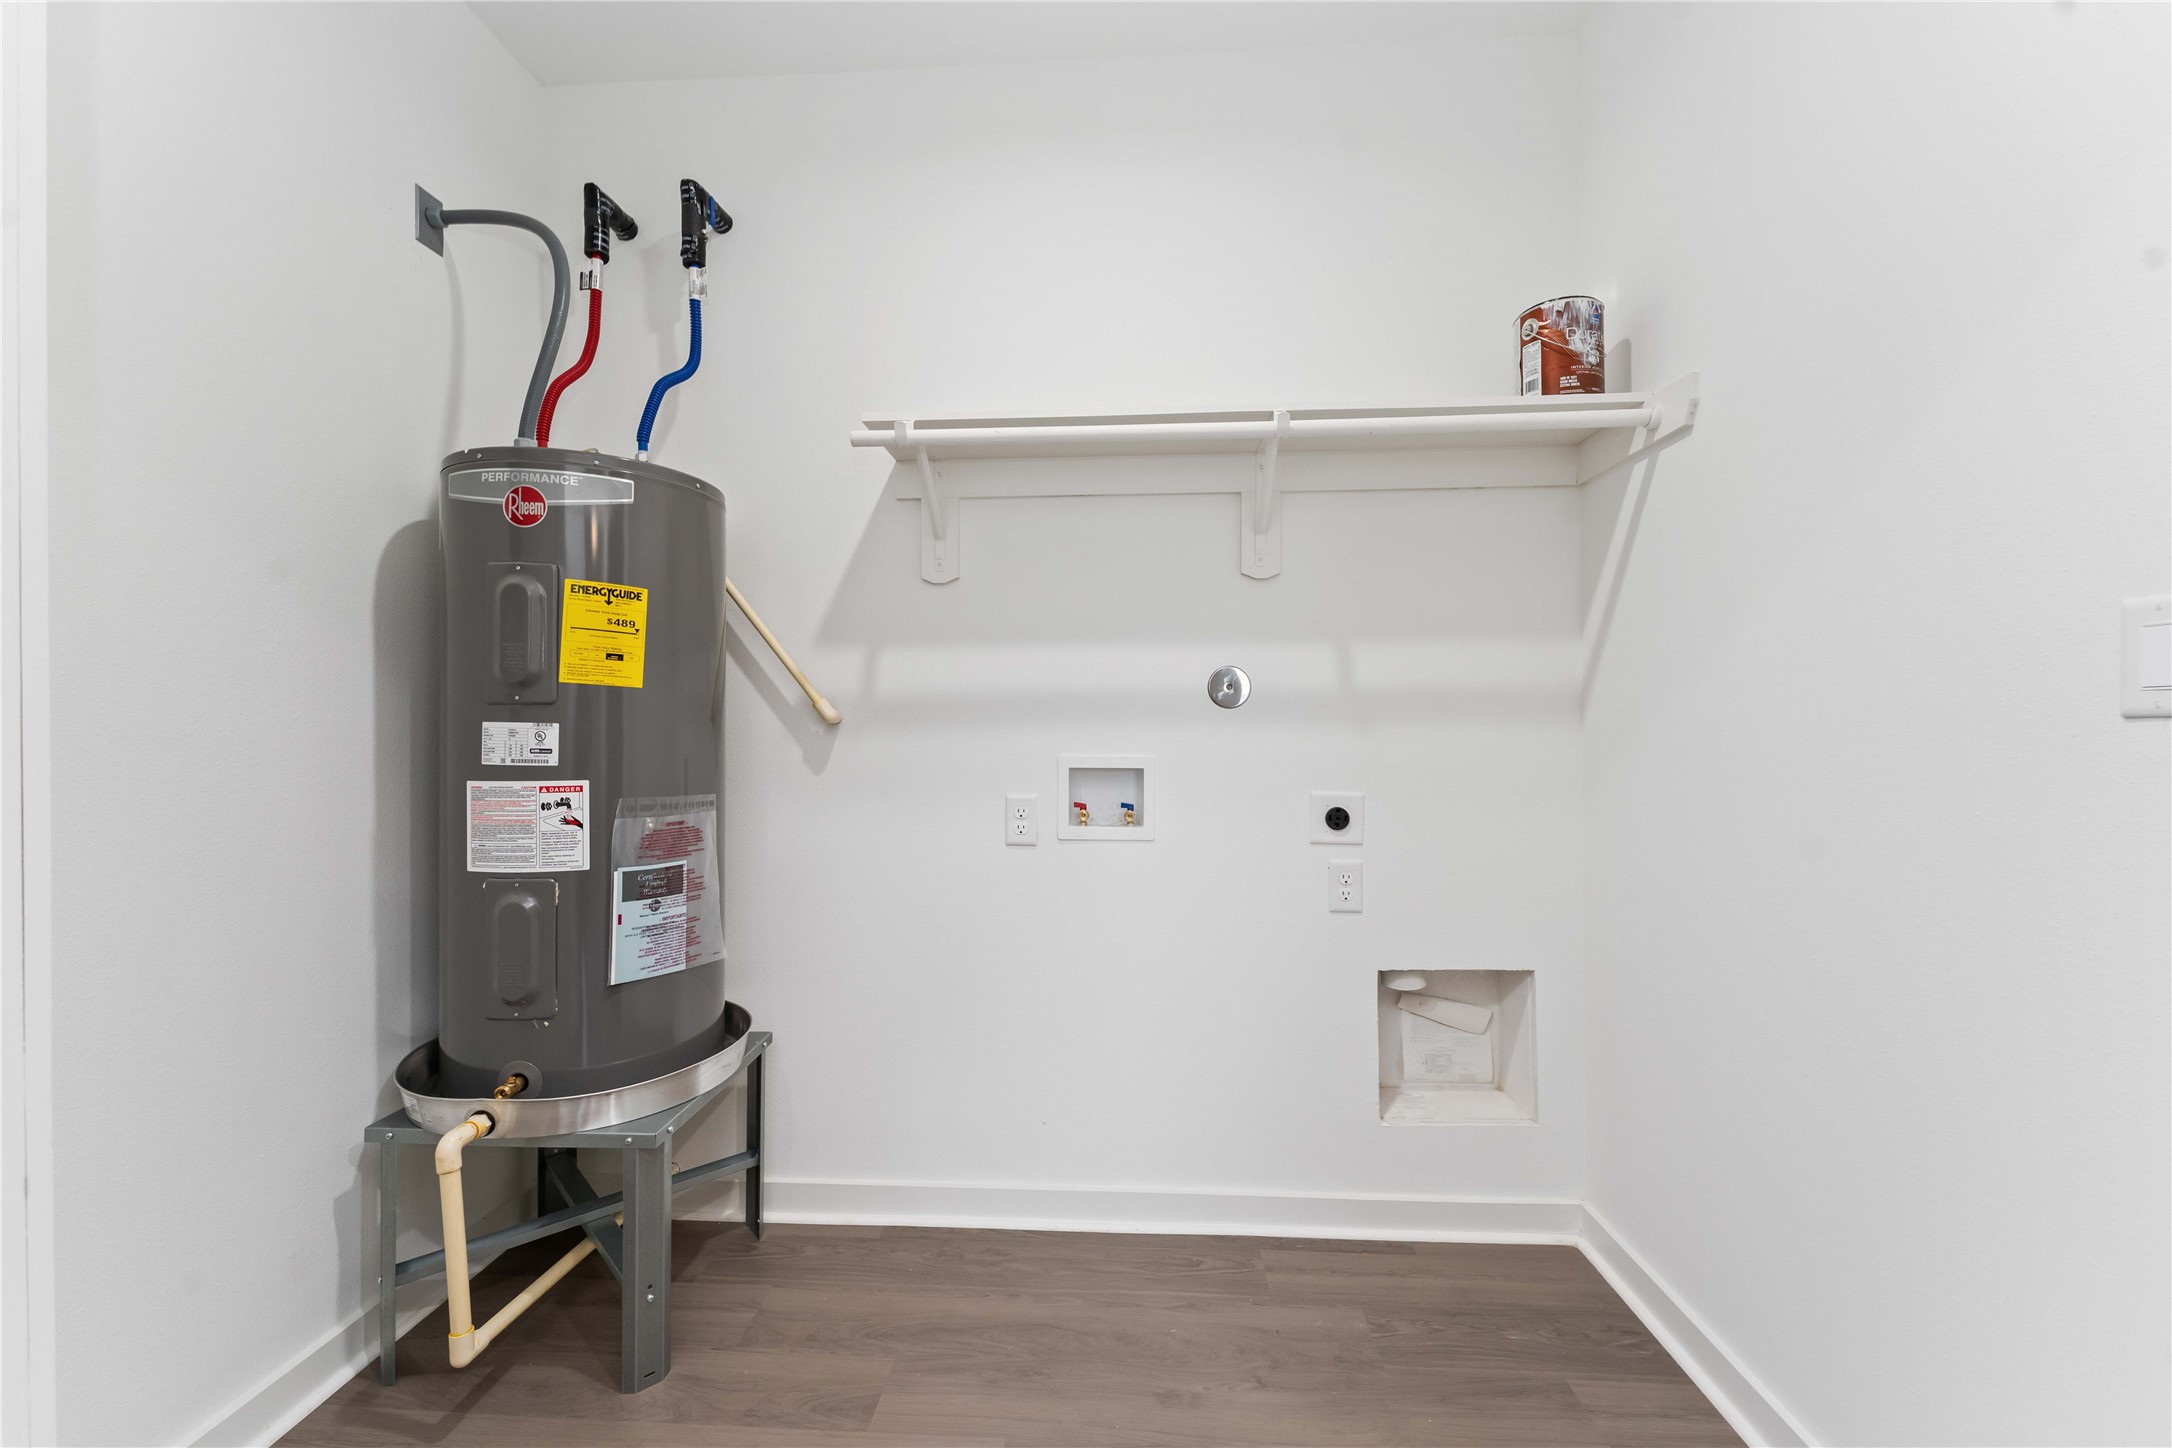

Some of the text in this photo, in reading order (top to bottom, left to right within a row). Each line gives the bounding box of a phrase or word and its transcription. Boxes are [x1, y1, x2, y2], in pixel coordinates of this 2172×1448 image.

[508, 486, 544, 520] Rheem
[570, 583, 643, 602] ENERGYGUIDE
[606, 617, 636, 629] $489
